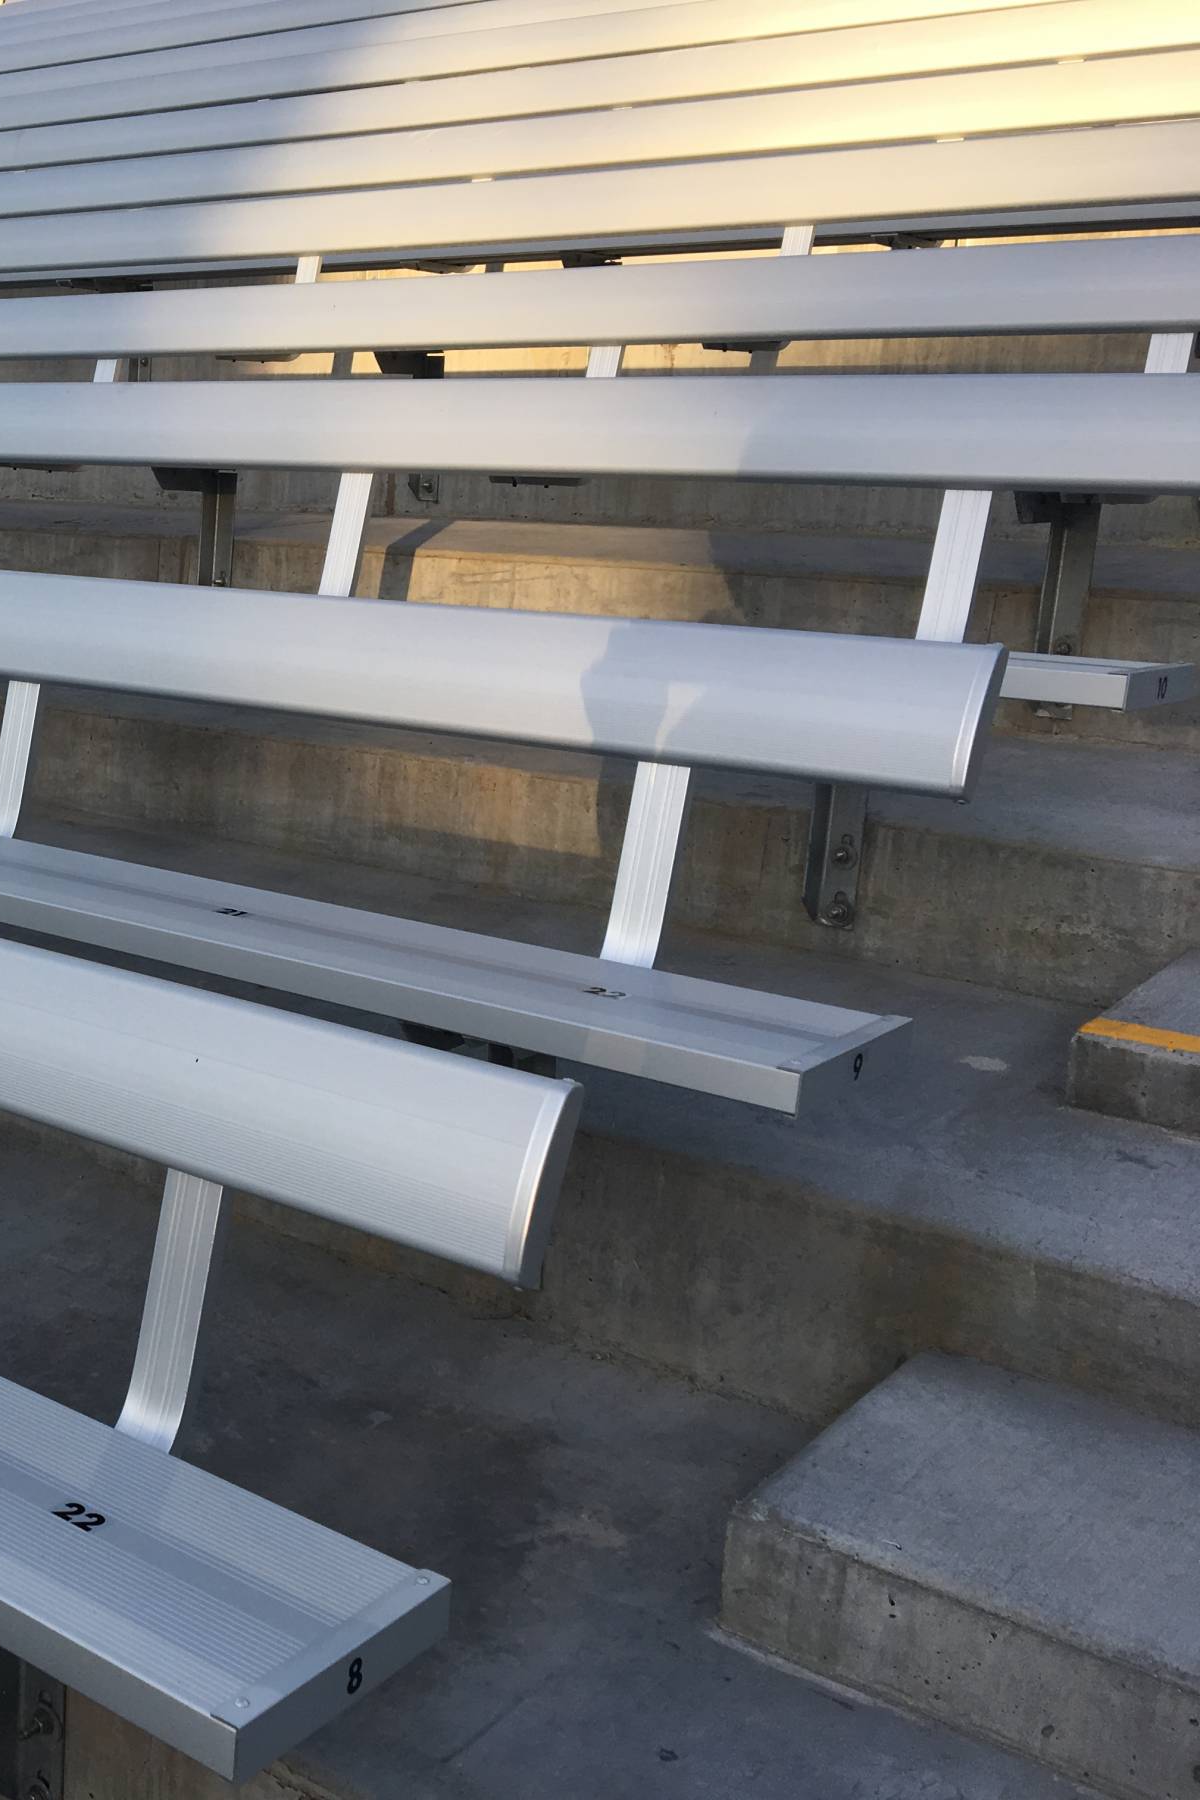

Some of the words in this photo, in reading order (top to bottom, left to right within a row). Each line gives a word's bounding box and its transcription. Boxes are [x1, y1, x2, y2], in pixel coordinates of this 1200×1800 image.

[1156, 676, 1168, 700] 10
[213, 907, 249, 917] 21
[582, 986, 627, 1000] 22
[853, 1053, 864, 1081] 9
[52, 1502, 106, 1532] 22
[346, 1657, 362, 1695] 8
